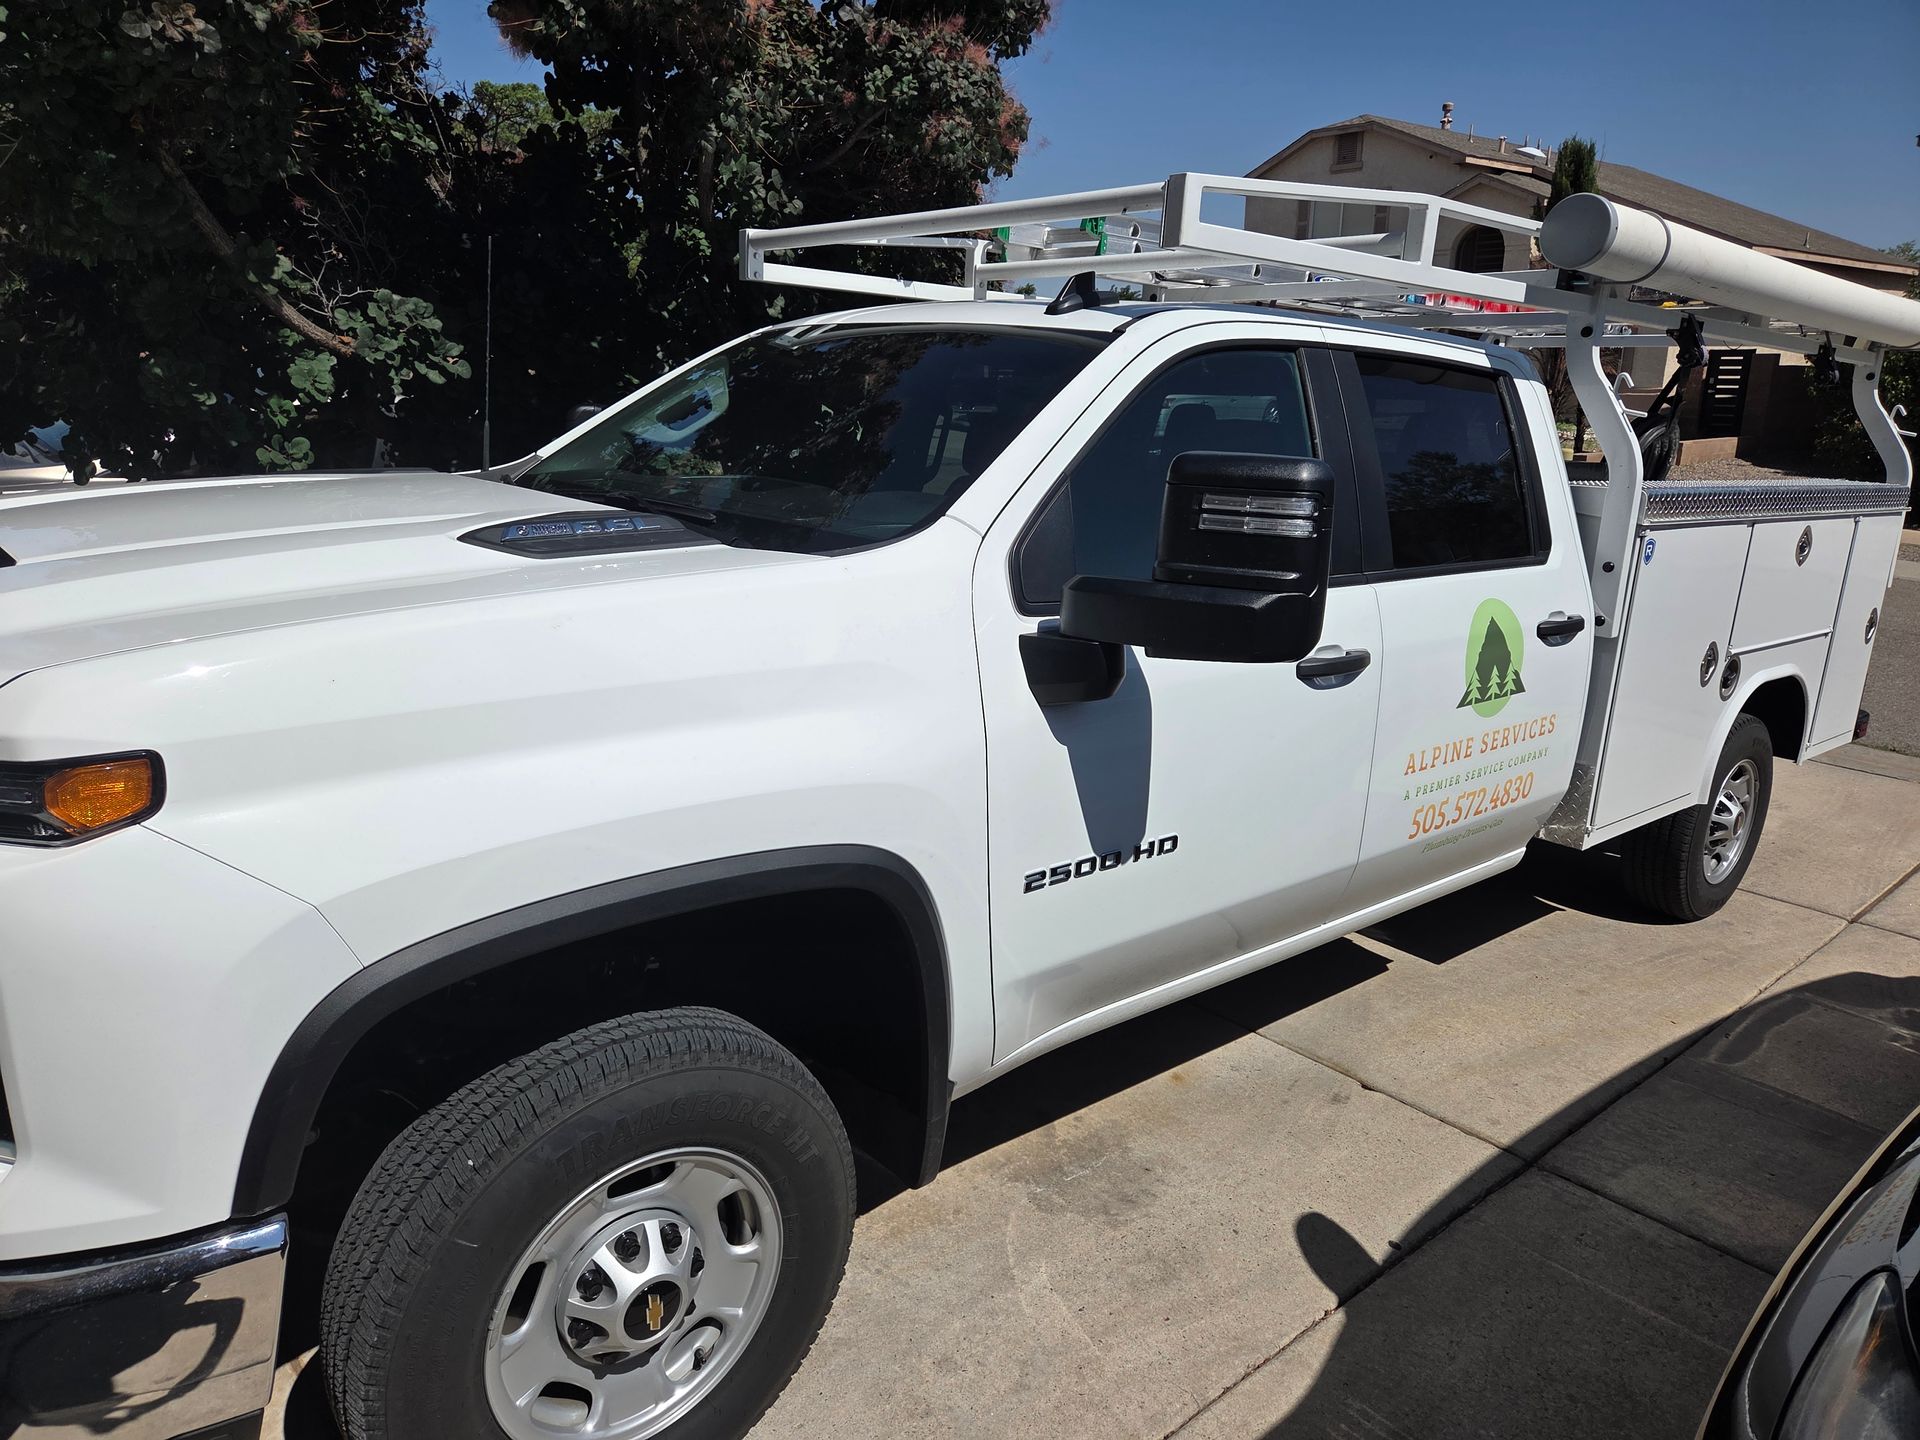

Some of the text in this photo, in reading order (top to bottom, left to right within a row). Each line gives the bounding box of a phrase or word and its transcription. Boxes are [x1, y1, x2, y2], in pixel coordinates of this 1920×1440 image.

[1403, 747, 1549, 801] A PREMIER SERVICE COMPANY
[1404, 713, 1557, 776] ALPINE SERVICES
[1407, 771, 1534, 840] 505.572.4830
[1023, 833, 1179, 894] 2500 HD
[554, 1092, 821, 1175] TRANSFORCE HT
